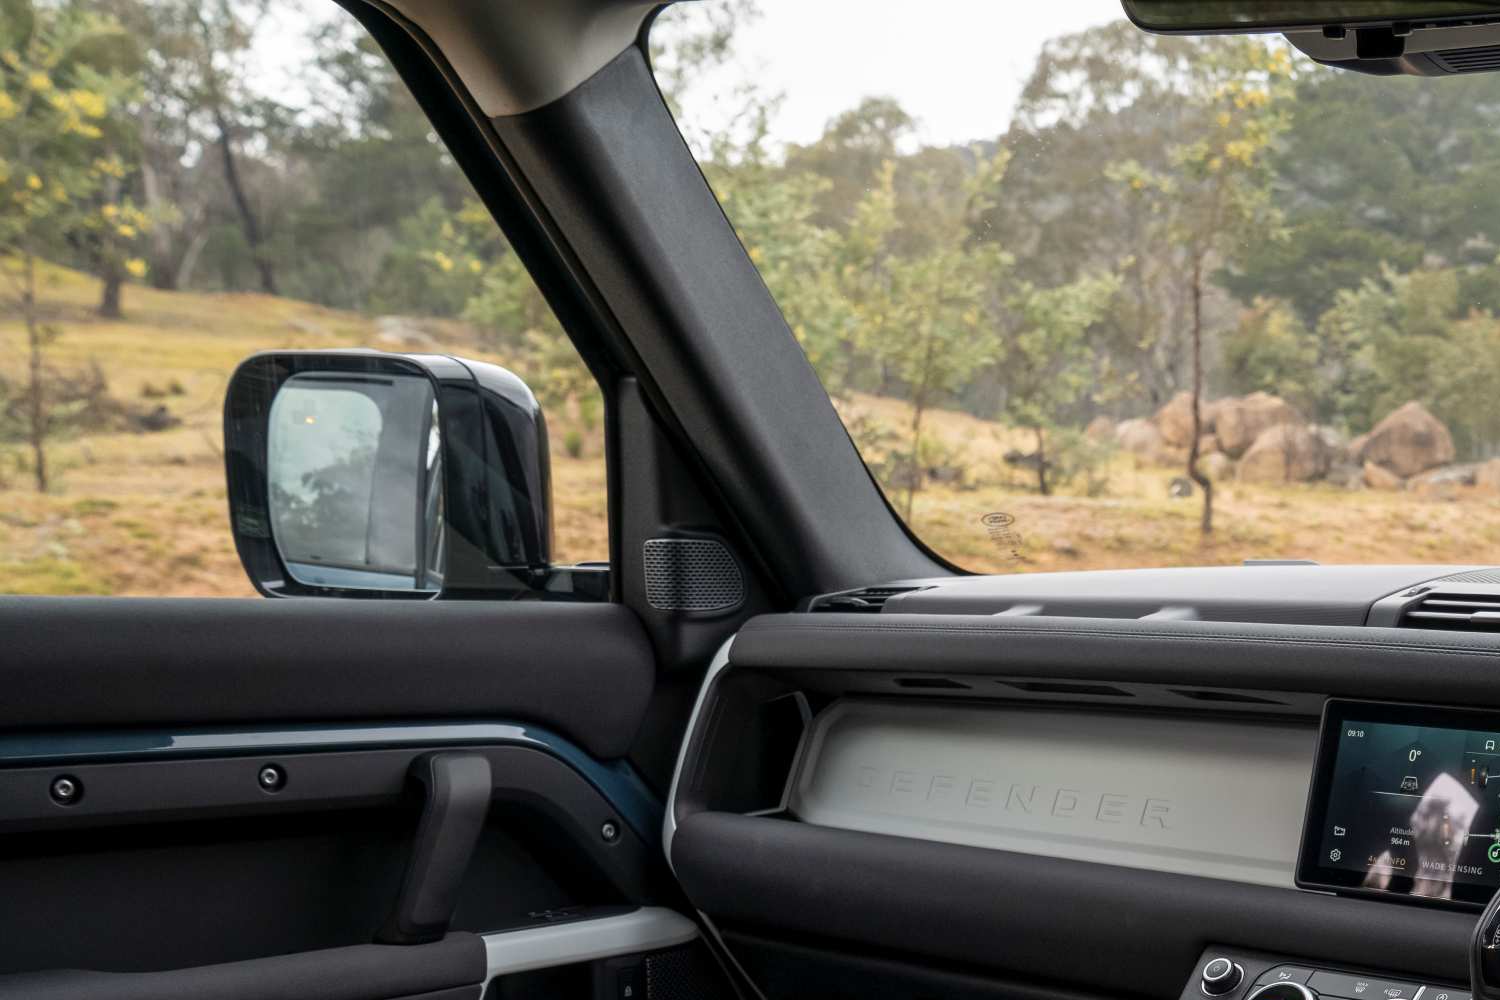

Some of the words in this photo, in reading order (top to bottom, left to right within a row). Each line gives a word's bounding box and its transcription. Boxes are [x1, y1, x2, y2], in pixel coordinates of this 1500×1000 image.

[1347, 730, 1365, 738] 09:10
[856, 765, 1174, 829] DEFENDER
[1422, 860, 1445, 871] WADE
[1447, 864, 1483, 875] SENSING
